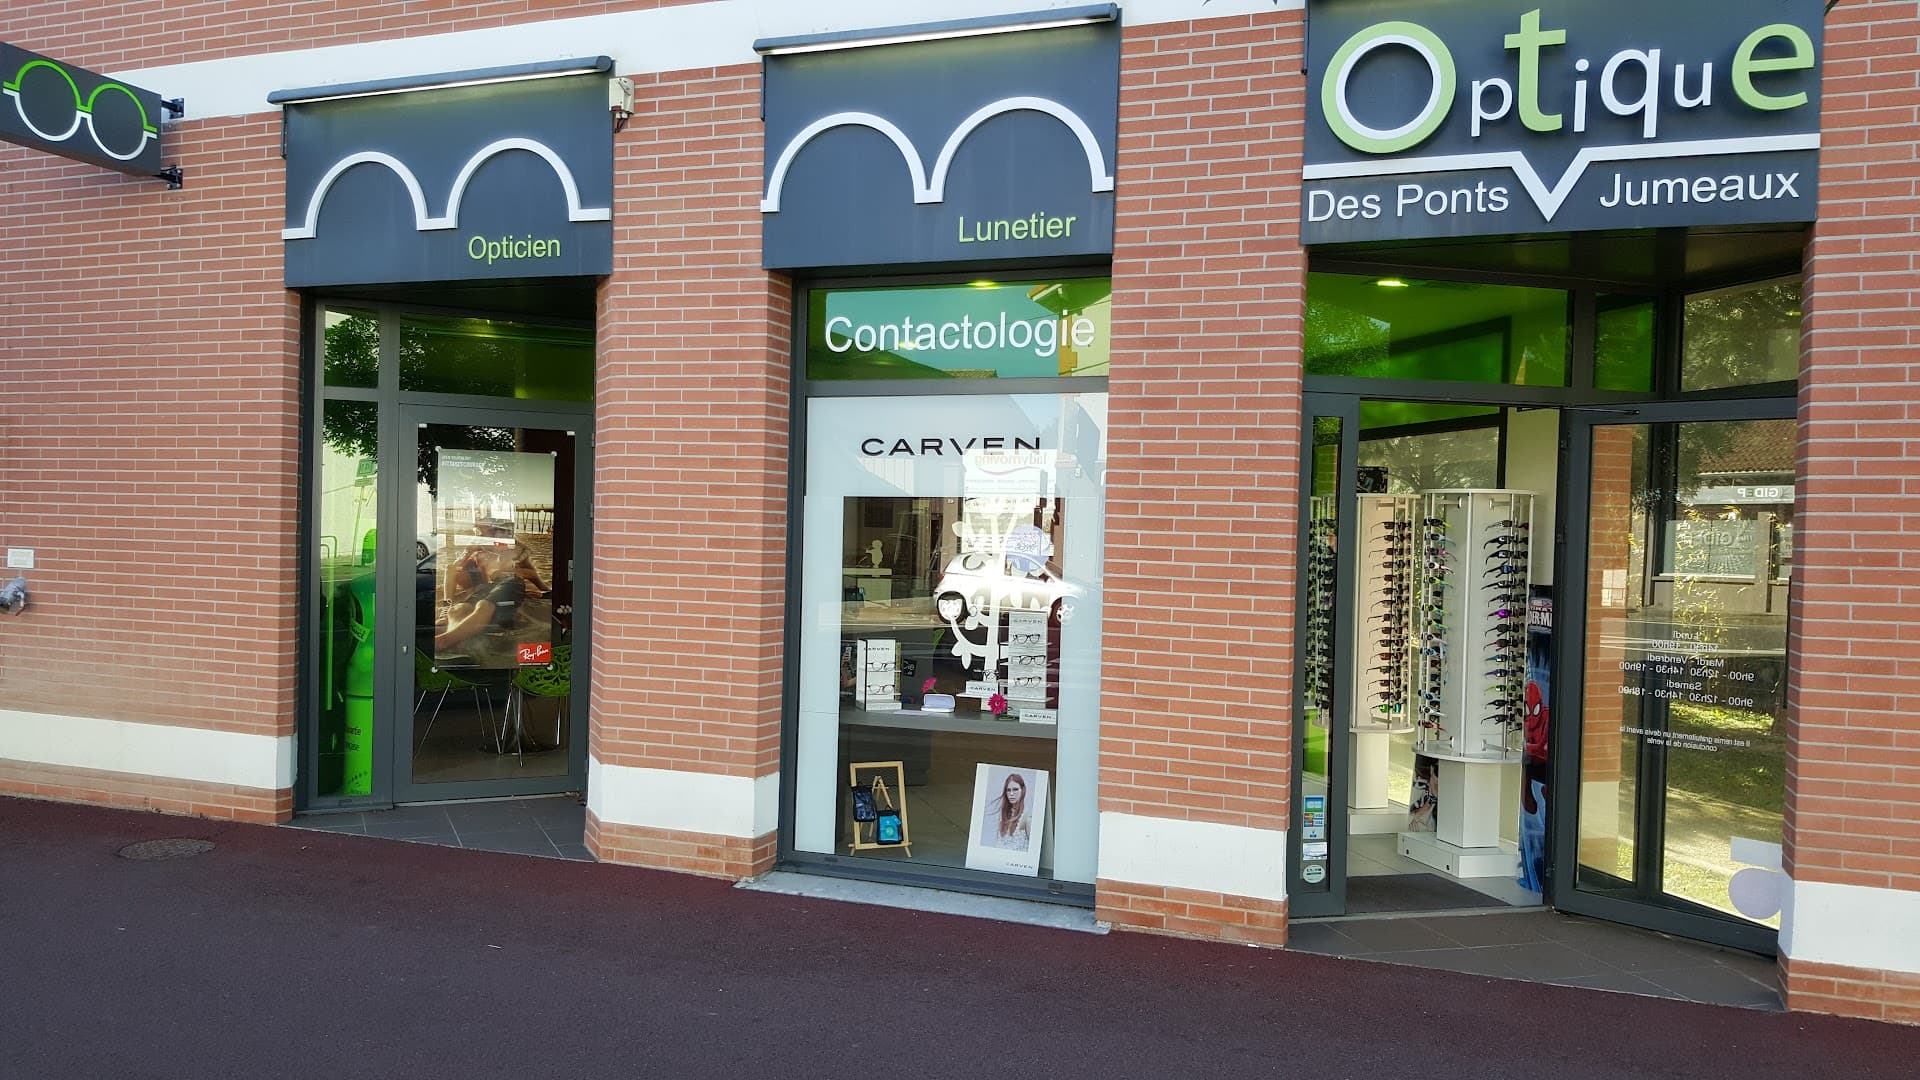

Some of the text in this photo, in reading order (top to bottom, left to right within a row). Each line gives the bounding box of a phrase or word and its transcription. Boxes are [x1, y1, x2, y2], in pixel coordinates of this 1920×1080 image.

[1321, 8, 1815, 154] Optique
[1308, 171, 1800, 222] Des Ponts Jumeaux
[958, 211, 1076, 243] Lunetier
[468, 234, 561, 265] Opticien
[825, 308, 1095, 357] Contactologie
[861, 436, 1041, 456] CARVEN
